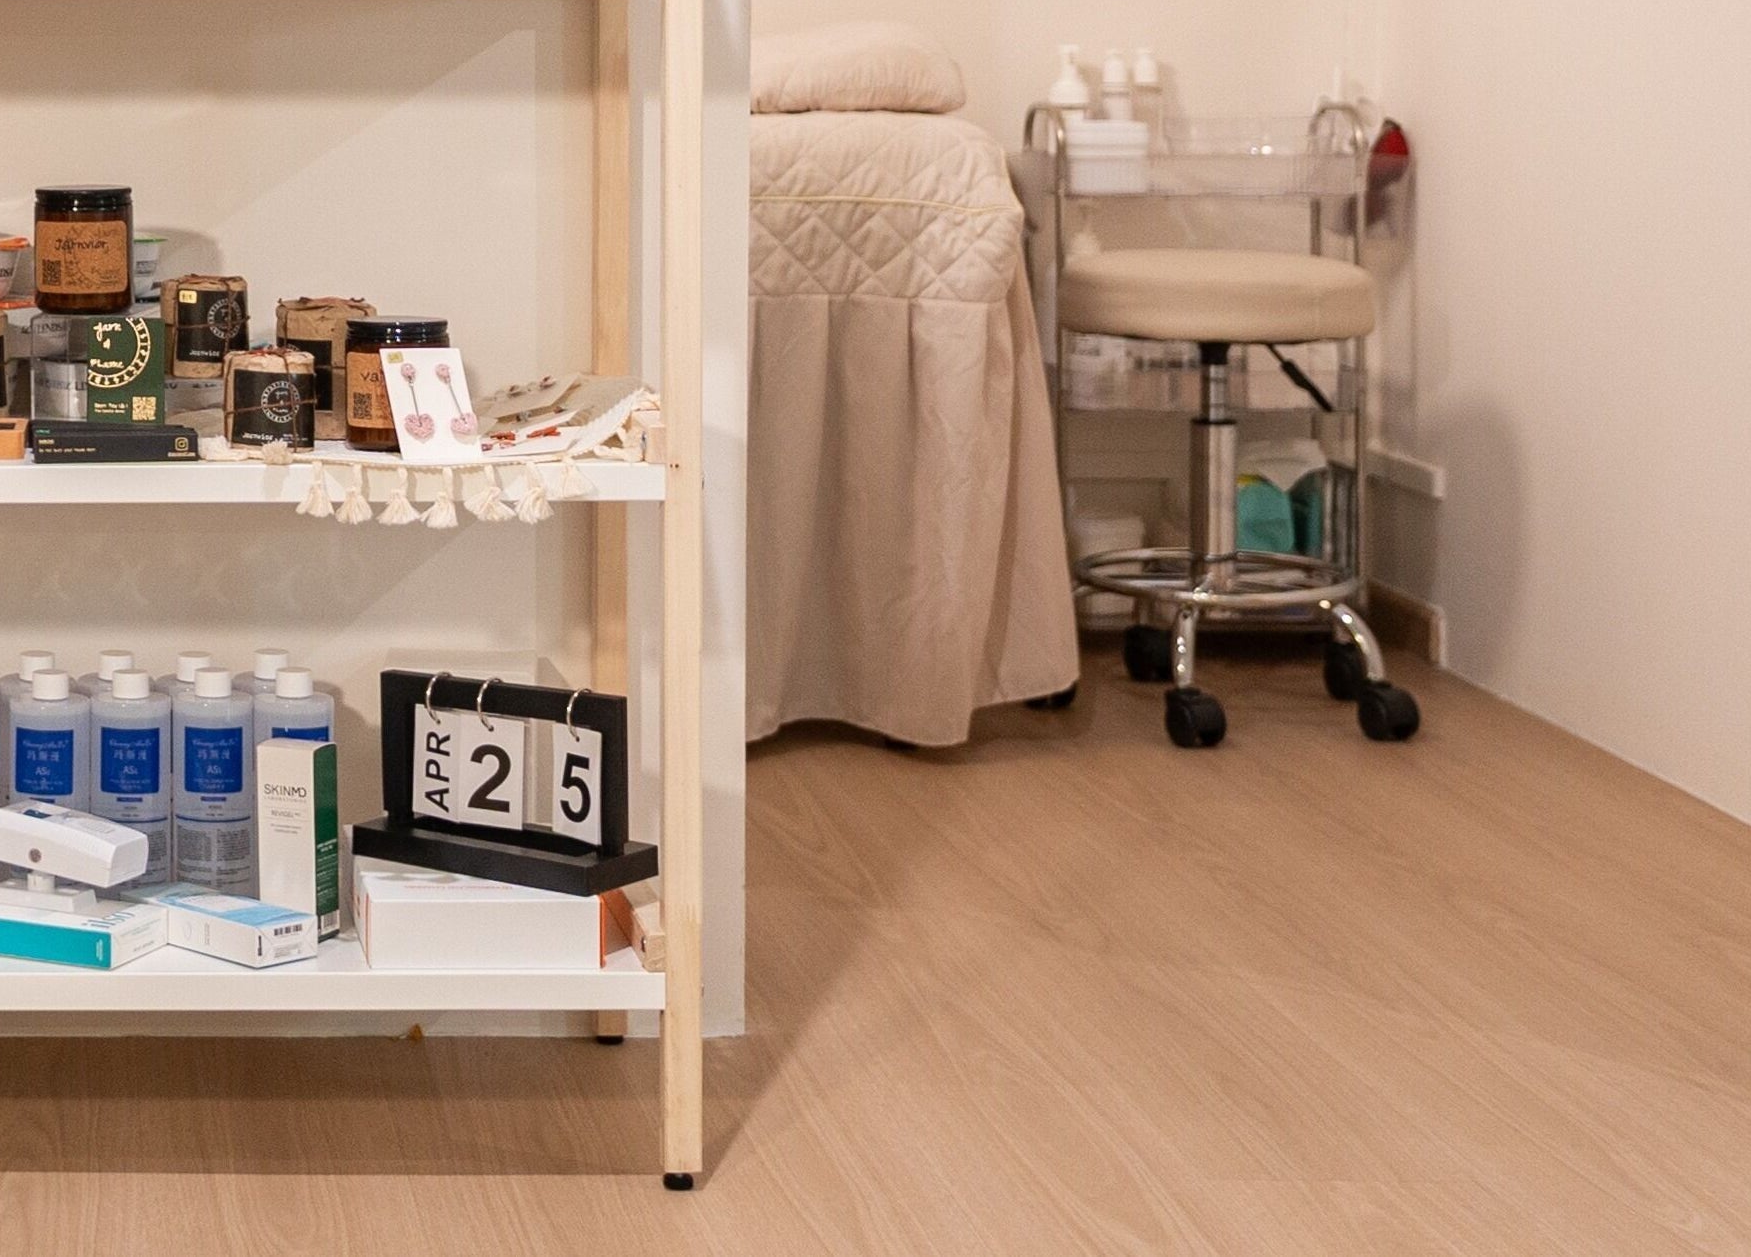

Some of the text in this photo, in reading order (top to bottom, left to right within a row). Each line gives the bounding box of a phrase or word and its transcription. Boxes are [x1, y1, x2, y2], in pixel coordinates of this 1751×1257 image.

[264, 783, 307, 798] SKINMD
[425, 730, 591, 823] APR 2 5
